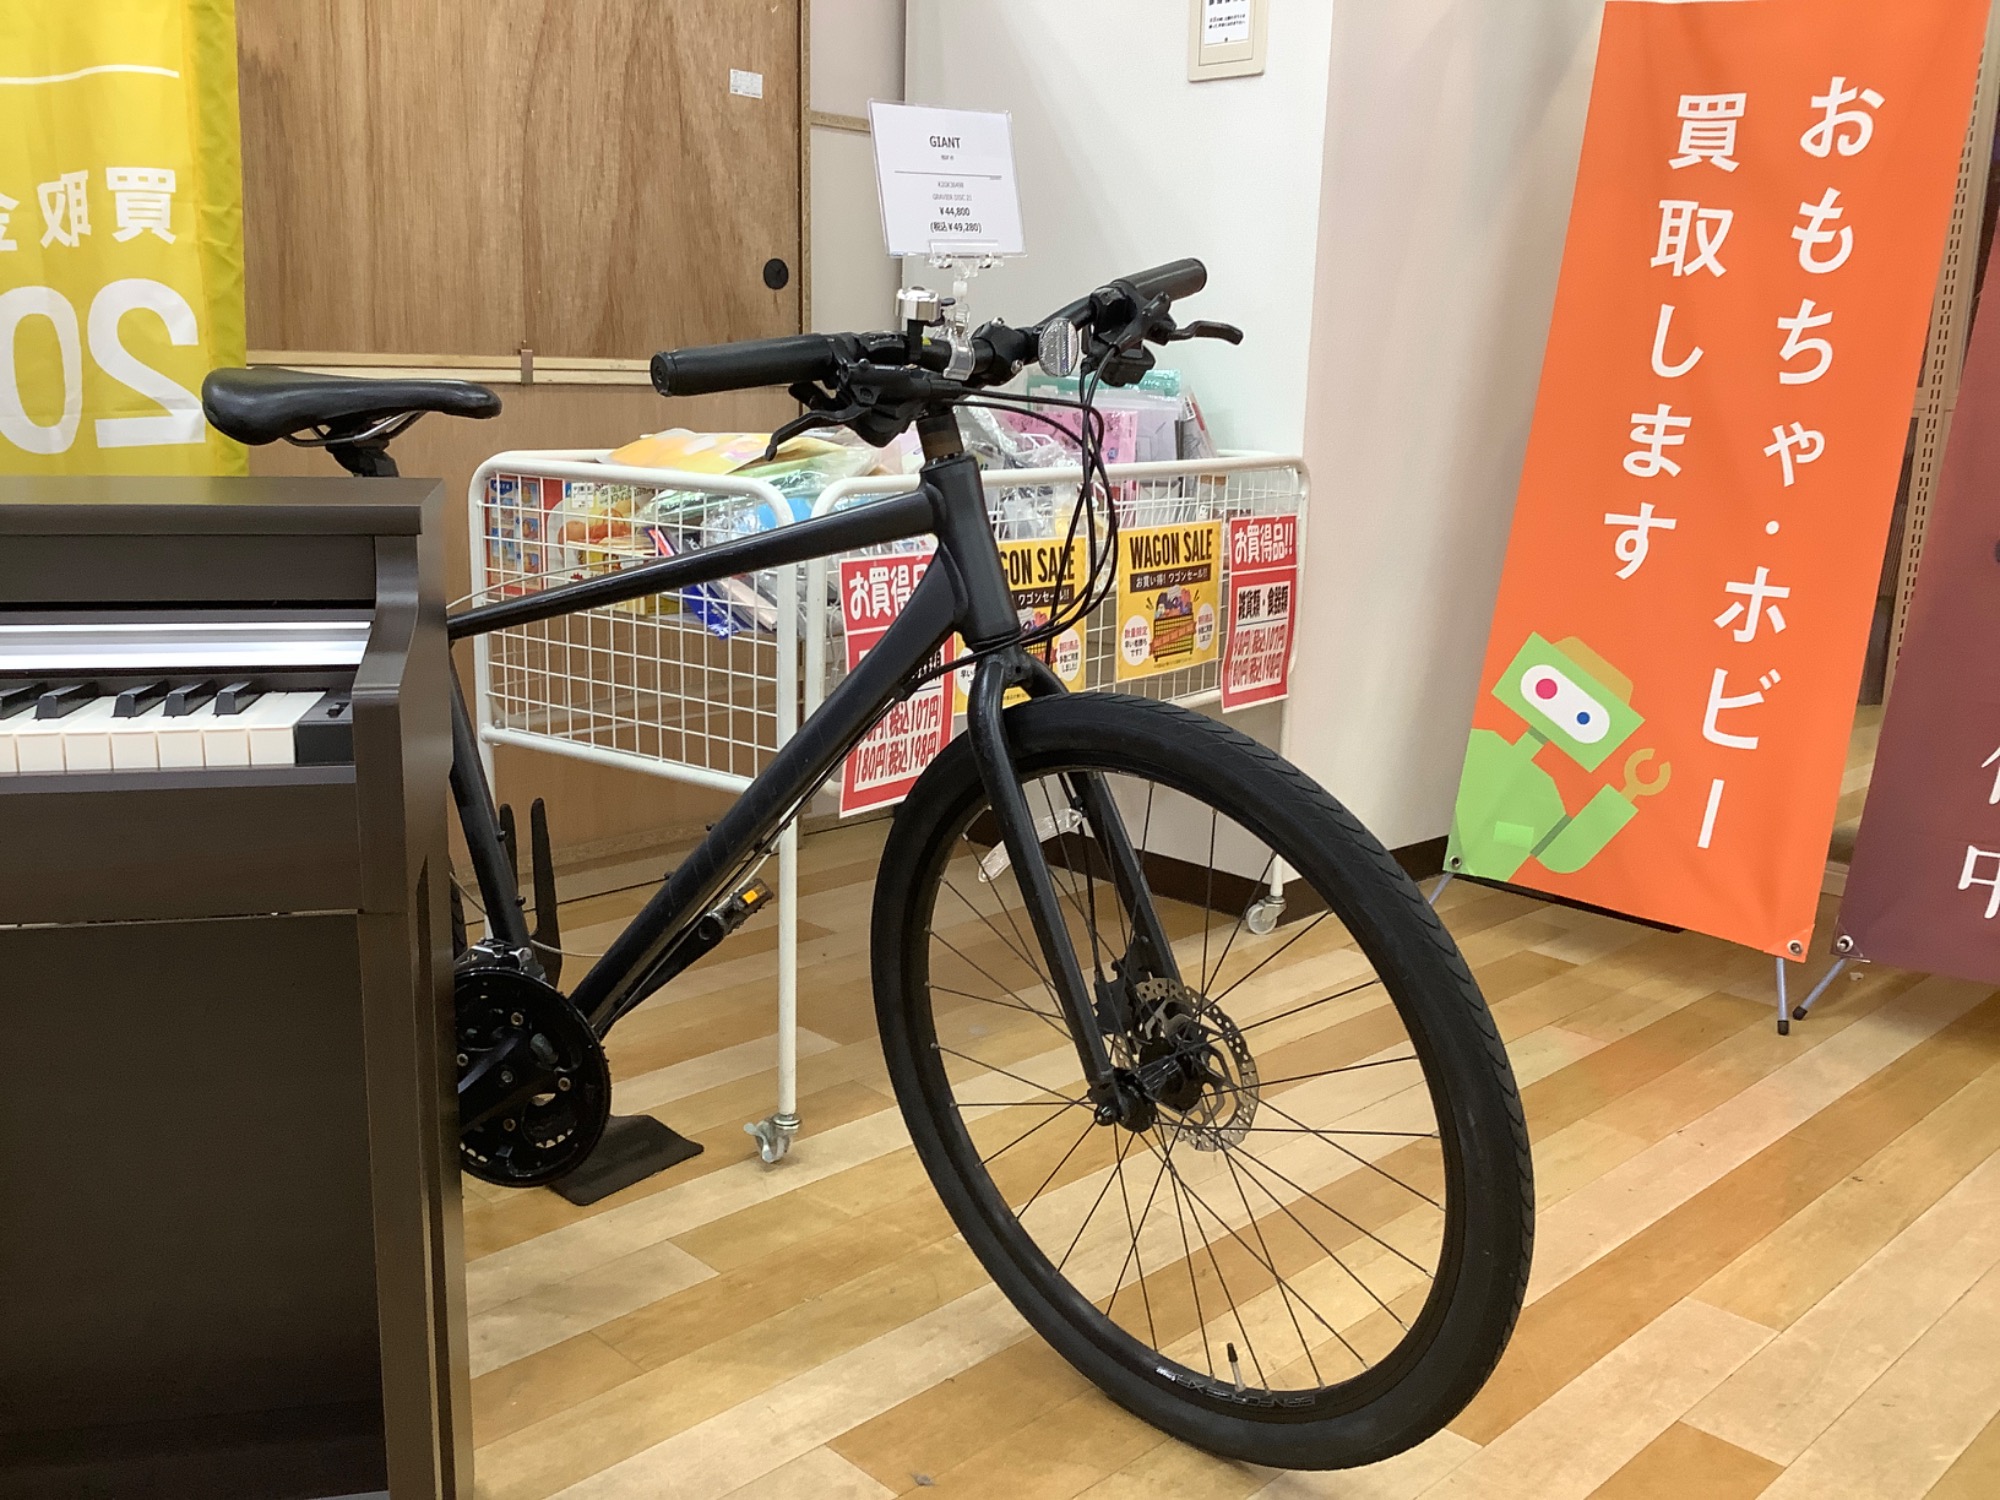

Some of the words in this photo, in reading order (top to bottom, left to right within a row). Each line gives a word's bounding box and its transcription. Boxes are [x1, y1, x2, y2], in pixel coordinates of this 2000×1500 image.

[929, 135, 960, 149] GIANT
[939, 207, 970, 217] ¥44,800
[1603, 92, 1748, 580] 買取します
[1696, 76, 1884, 850] おもちゃ・ホビー
[1130, 532, 1180, 570] WAGON
[1184, 528, 1213, 563] SALE
